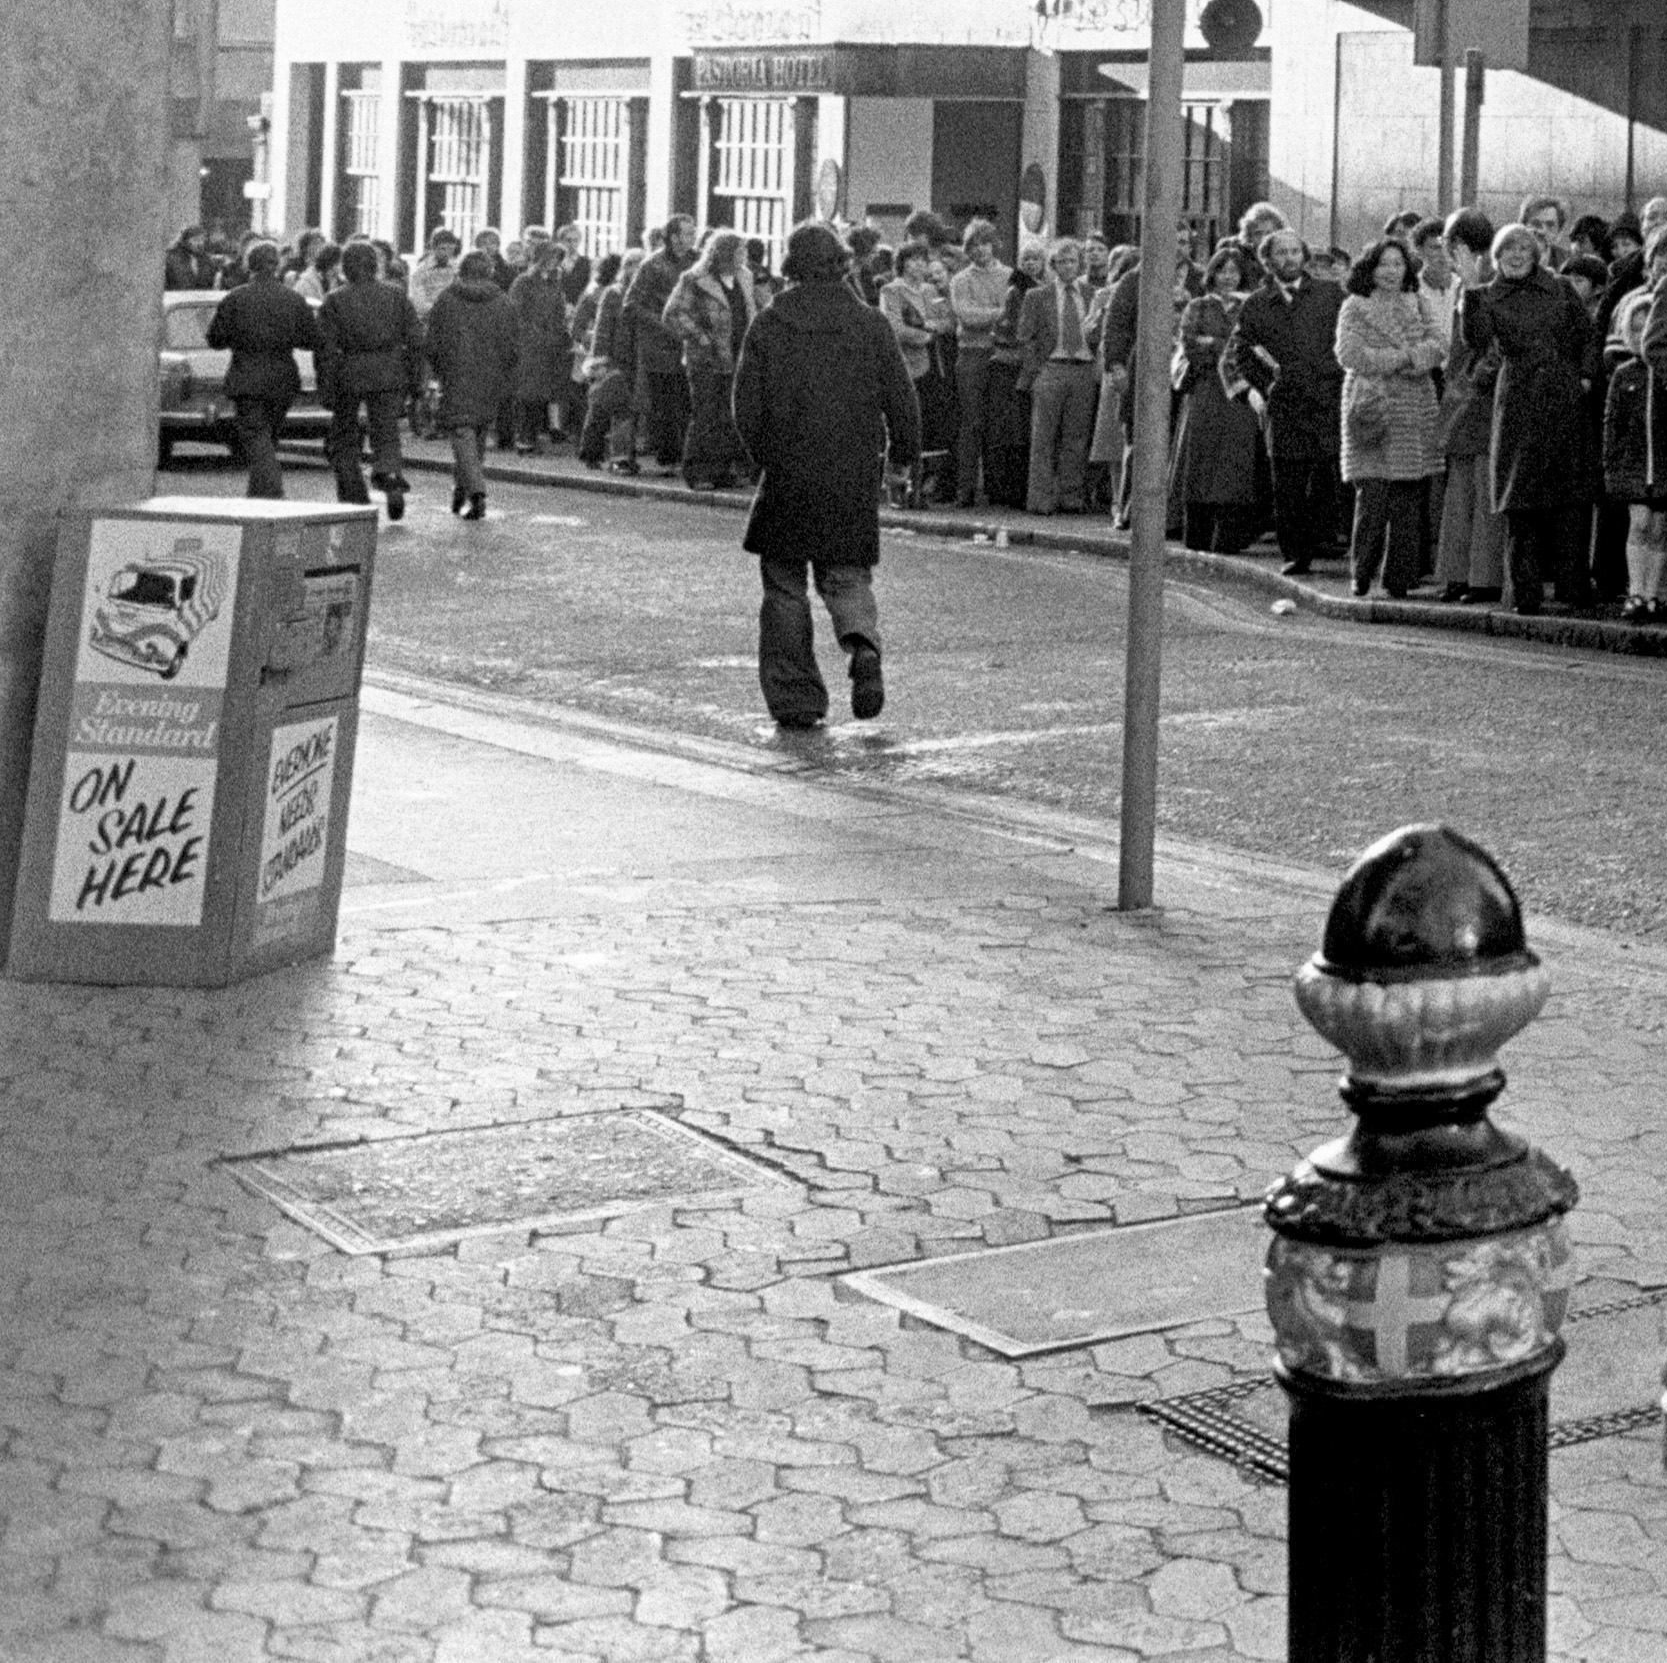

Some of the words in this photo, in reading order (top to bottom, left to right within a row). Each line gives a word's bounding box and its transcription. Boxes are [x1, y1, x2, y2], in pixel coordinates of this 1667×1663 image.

[74, 715, 218, 749] Standard
[94, 689, 201, 725] Evening
[69, 758, 136, 815] ON
[89, 785, 199, 857] SALE
[75, 833, 204, 912] HERE
